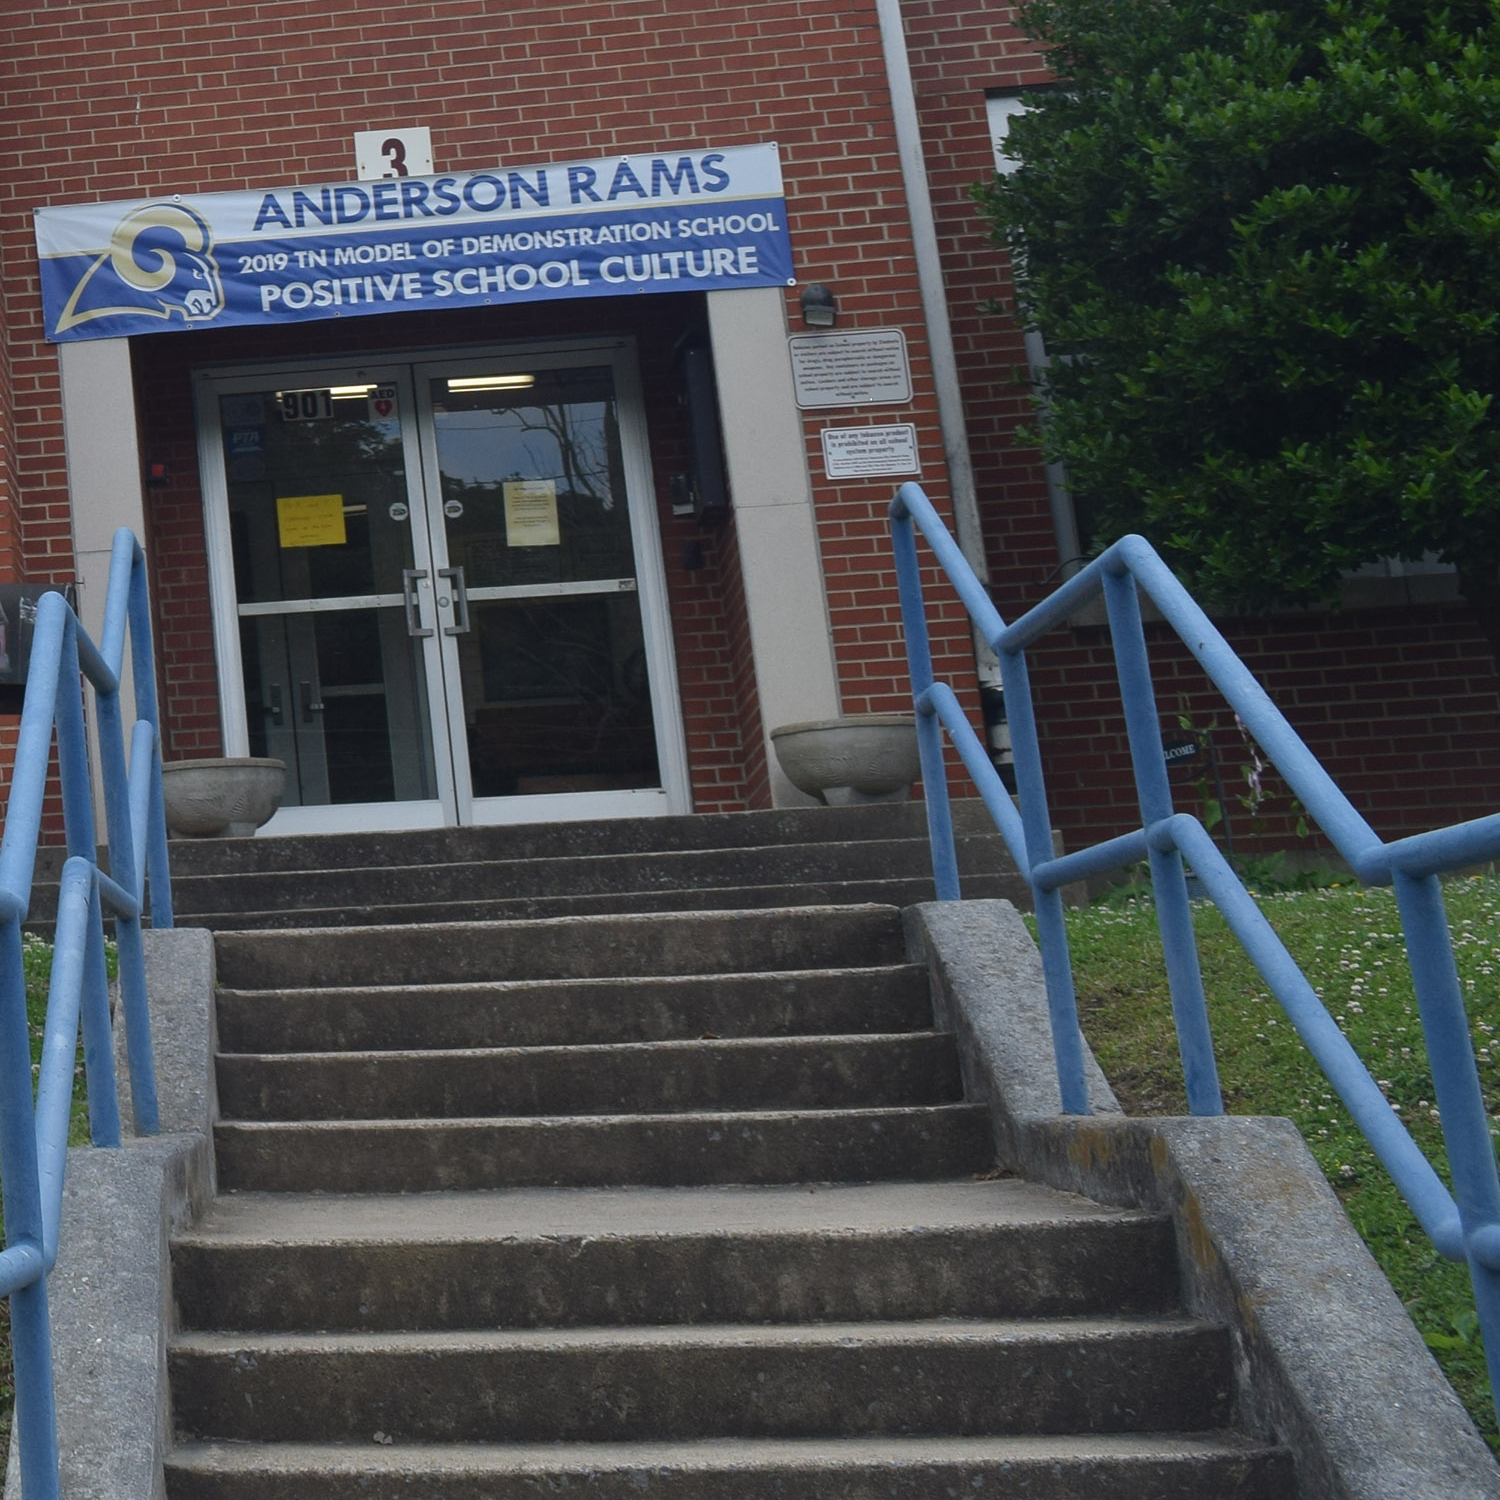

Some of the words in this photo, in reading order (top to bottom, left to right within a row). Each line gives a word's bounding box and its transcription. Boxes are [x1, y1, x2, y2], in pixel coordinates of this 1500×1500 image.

[381, 137, 409, 178] 3
[252, 169, 551, 231] ANDERSON
[567, 153, 731, 204] RAMS
[237, 252, 289, 275] 2019
[294, 249, 328, 269] TN
[333, 241, 416, 266] MODEL
[422, 238, 456, 258] OF
[462, 220, 672, 256] DEMONSTRATION
[677, 212, 780, 240] SCHOOL
[259, 272, 424, 312] POSITIVE
[432, 259, 591, 298] SCHOOL
[599, 246, 760, 284] CULTURE
[283, 389, 332, 419] 901
[370, 388, 395, 400] AED
